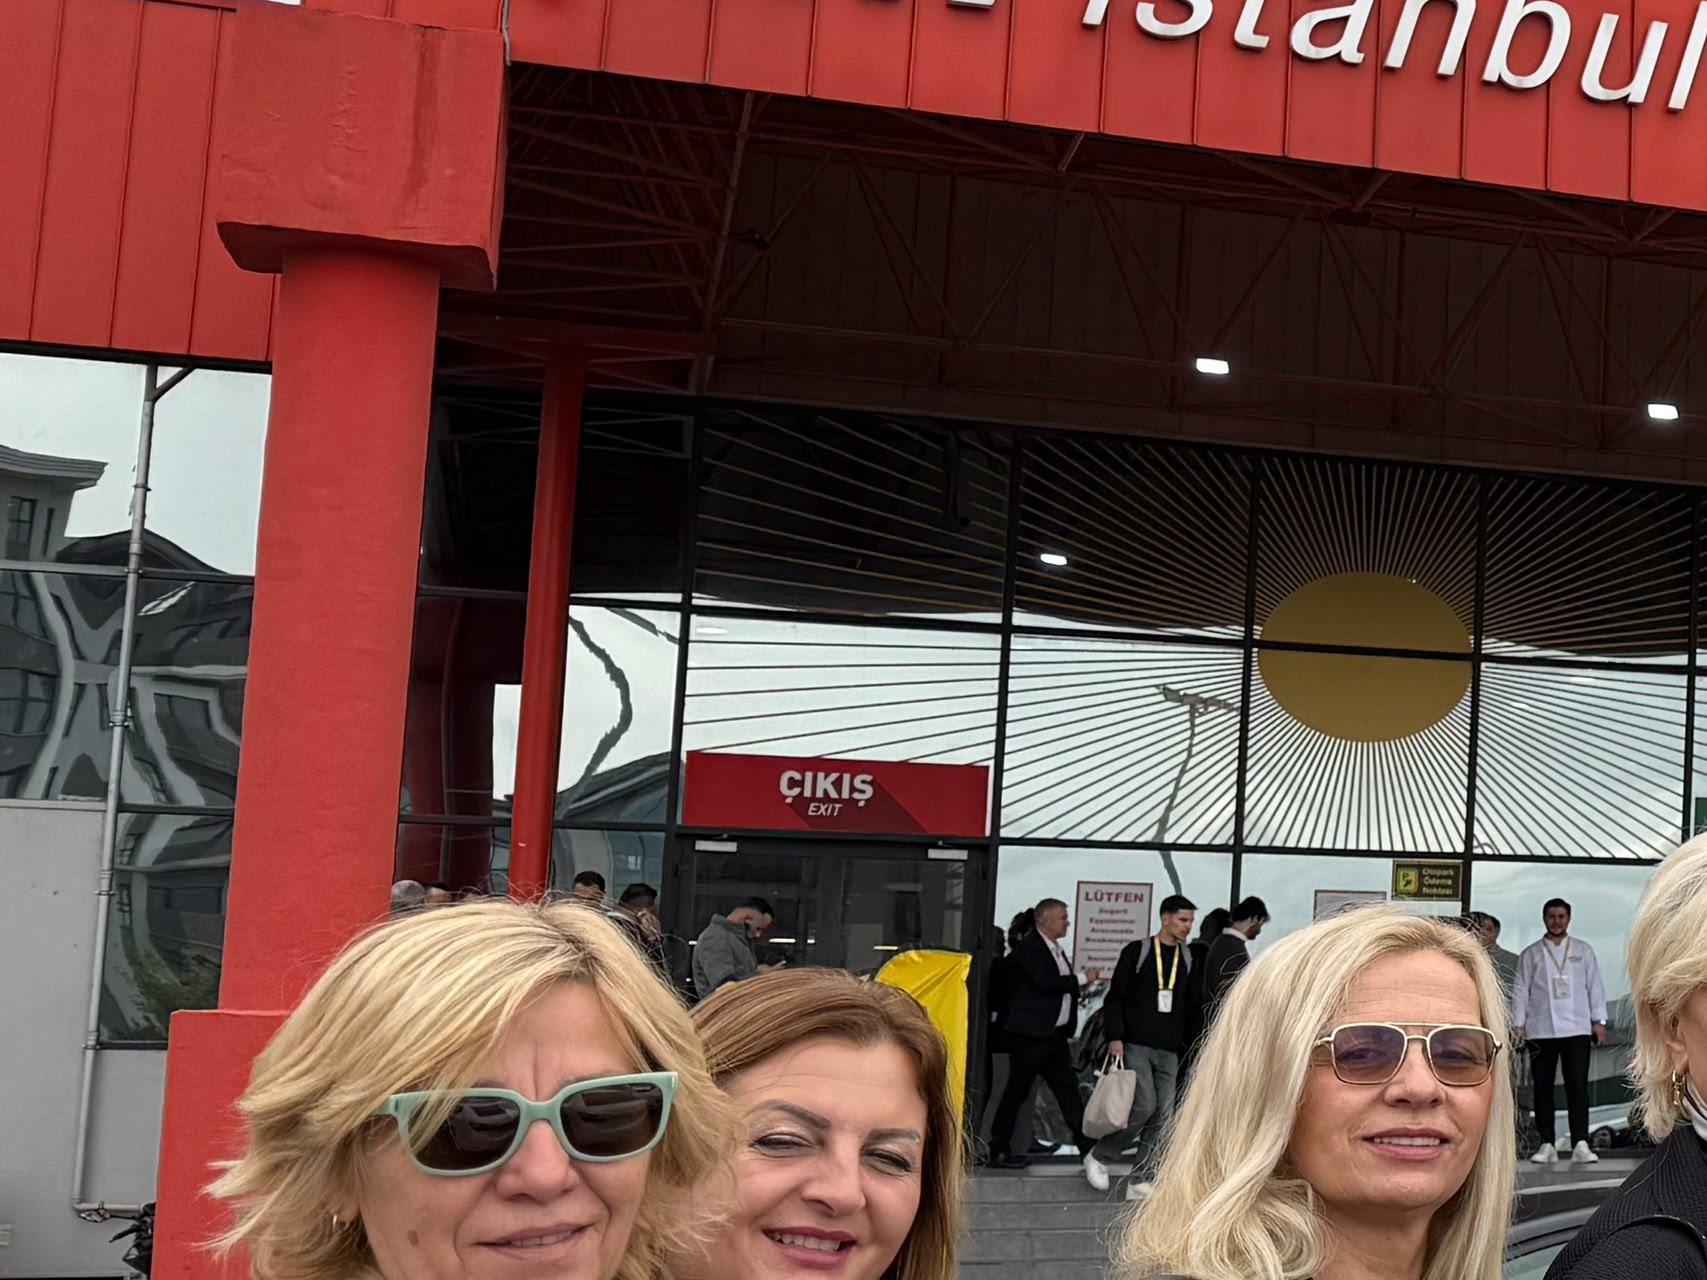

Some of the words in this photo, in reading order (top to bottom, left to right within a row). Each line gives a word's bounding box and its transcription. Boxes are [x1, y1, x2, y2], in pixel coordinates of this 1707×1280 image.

[779, 770, 874, 807] ÇIKIŞ
[807, 802, 843, 817] EXIT
[1084, 889, 1145, 903] LÜTFEN
